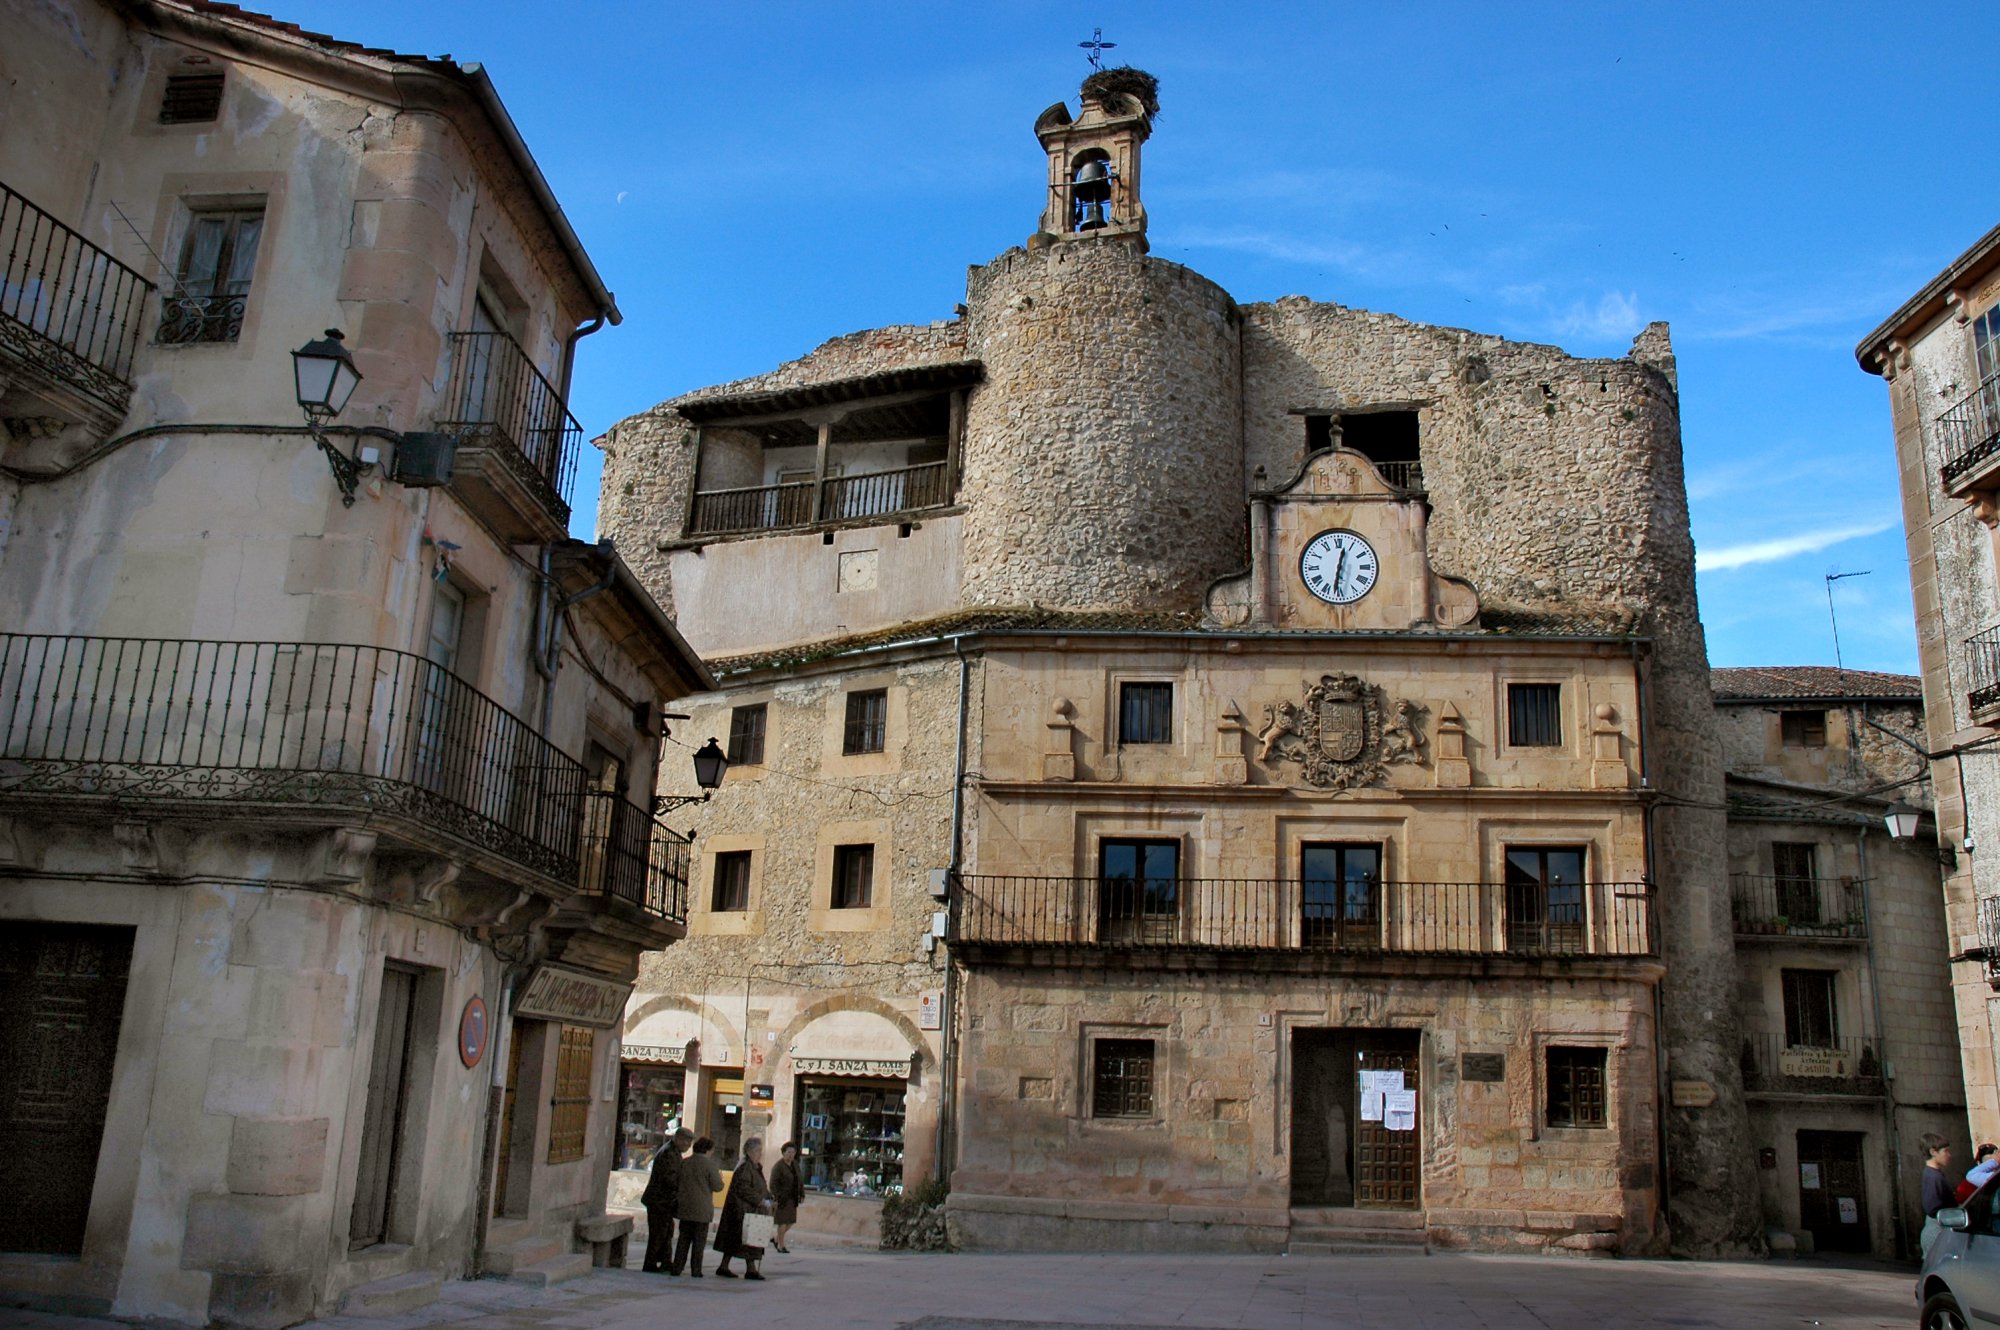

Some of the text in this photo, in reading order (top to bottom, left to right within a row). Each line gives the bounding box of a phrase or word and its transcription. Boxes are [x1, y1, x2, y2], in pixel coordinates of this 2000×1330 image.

[620, 1046, 651, 1057] SANZA
[658, 1047, 681, 1055] TAXIS
[828, 1059, 869, 1072] SANZA
[877, 1060, 904, 1069] TAXIS
